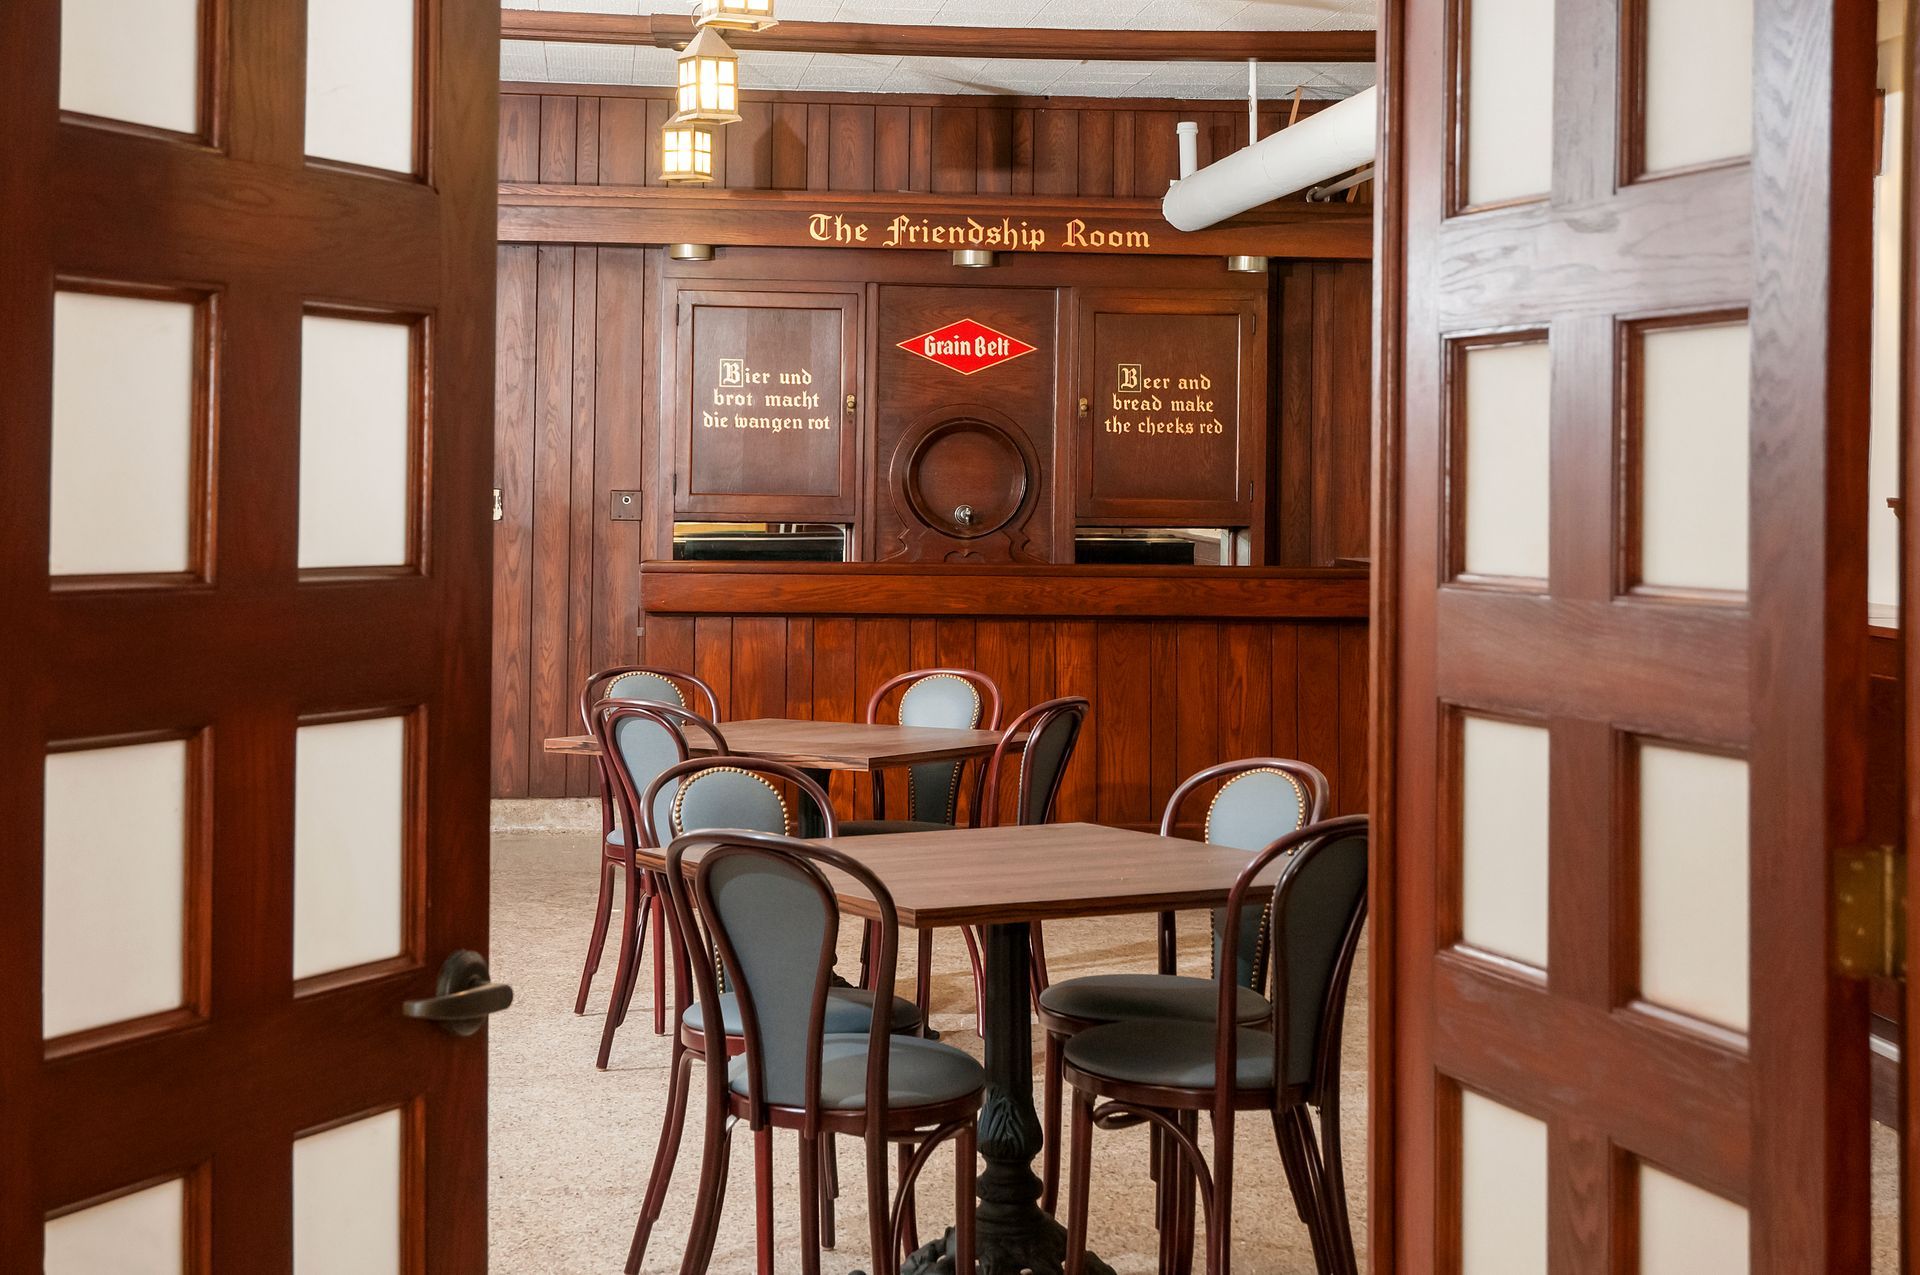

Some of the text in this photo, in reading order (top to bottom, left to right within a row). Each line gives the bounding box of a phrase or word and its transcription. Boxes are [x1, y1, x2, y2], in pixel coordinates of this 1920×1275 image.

[808, 212, 1151, 251] The Friendship Room
[924, 335, 1010, 358] Grain Belt
[722, 361, 812, 385] Bier und
[1120, 367, 1211, 390] Beer and
[713, 388, 820, 410] brot macht
[1112, 392, 1214, 413] bread make
[702, 410, 831, 434] die wangen rot
[1104, 415, 1223, 436] the cheeks red
